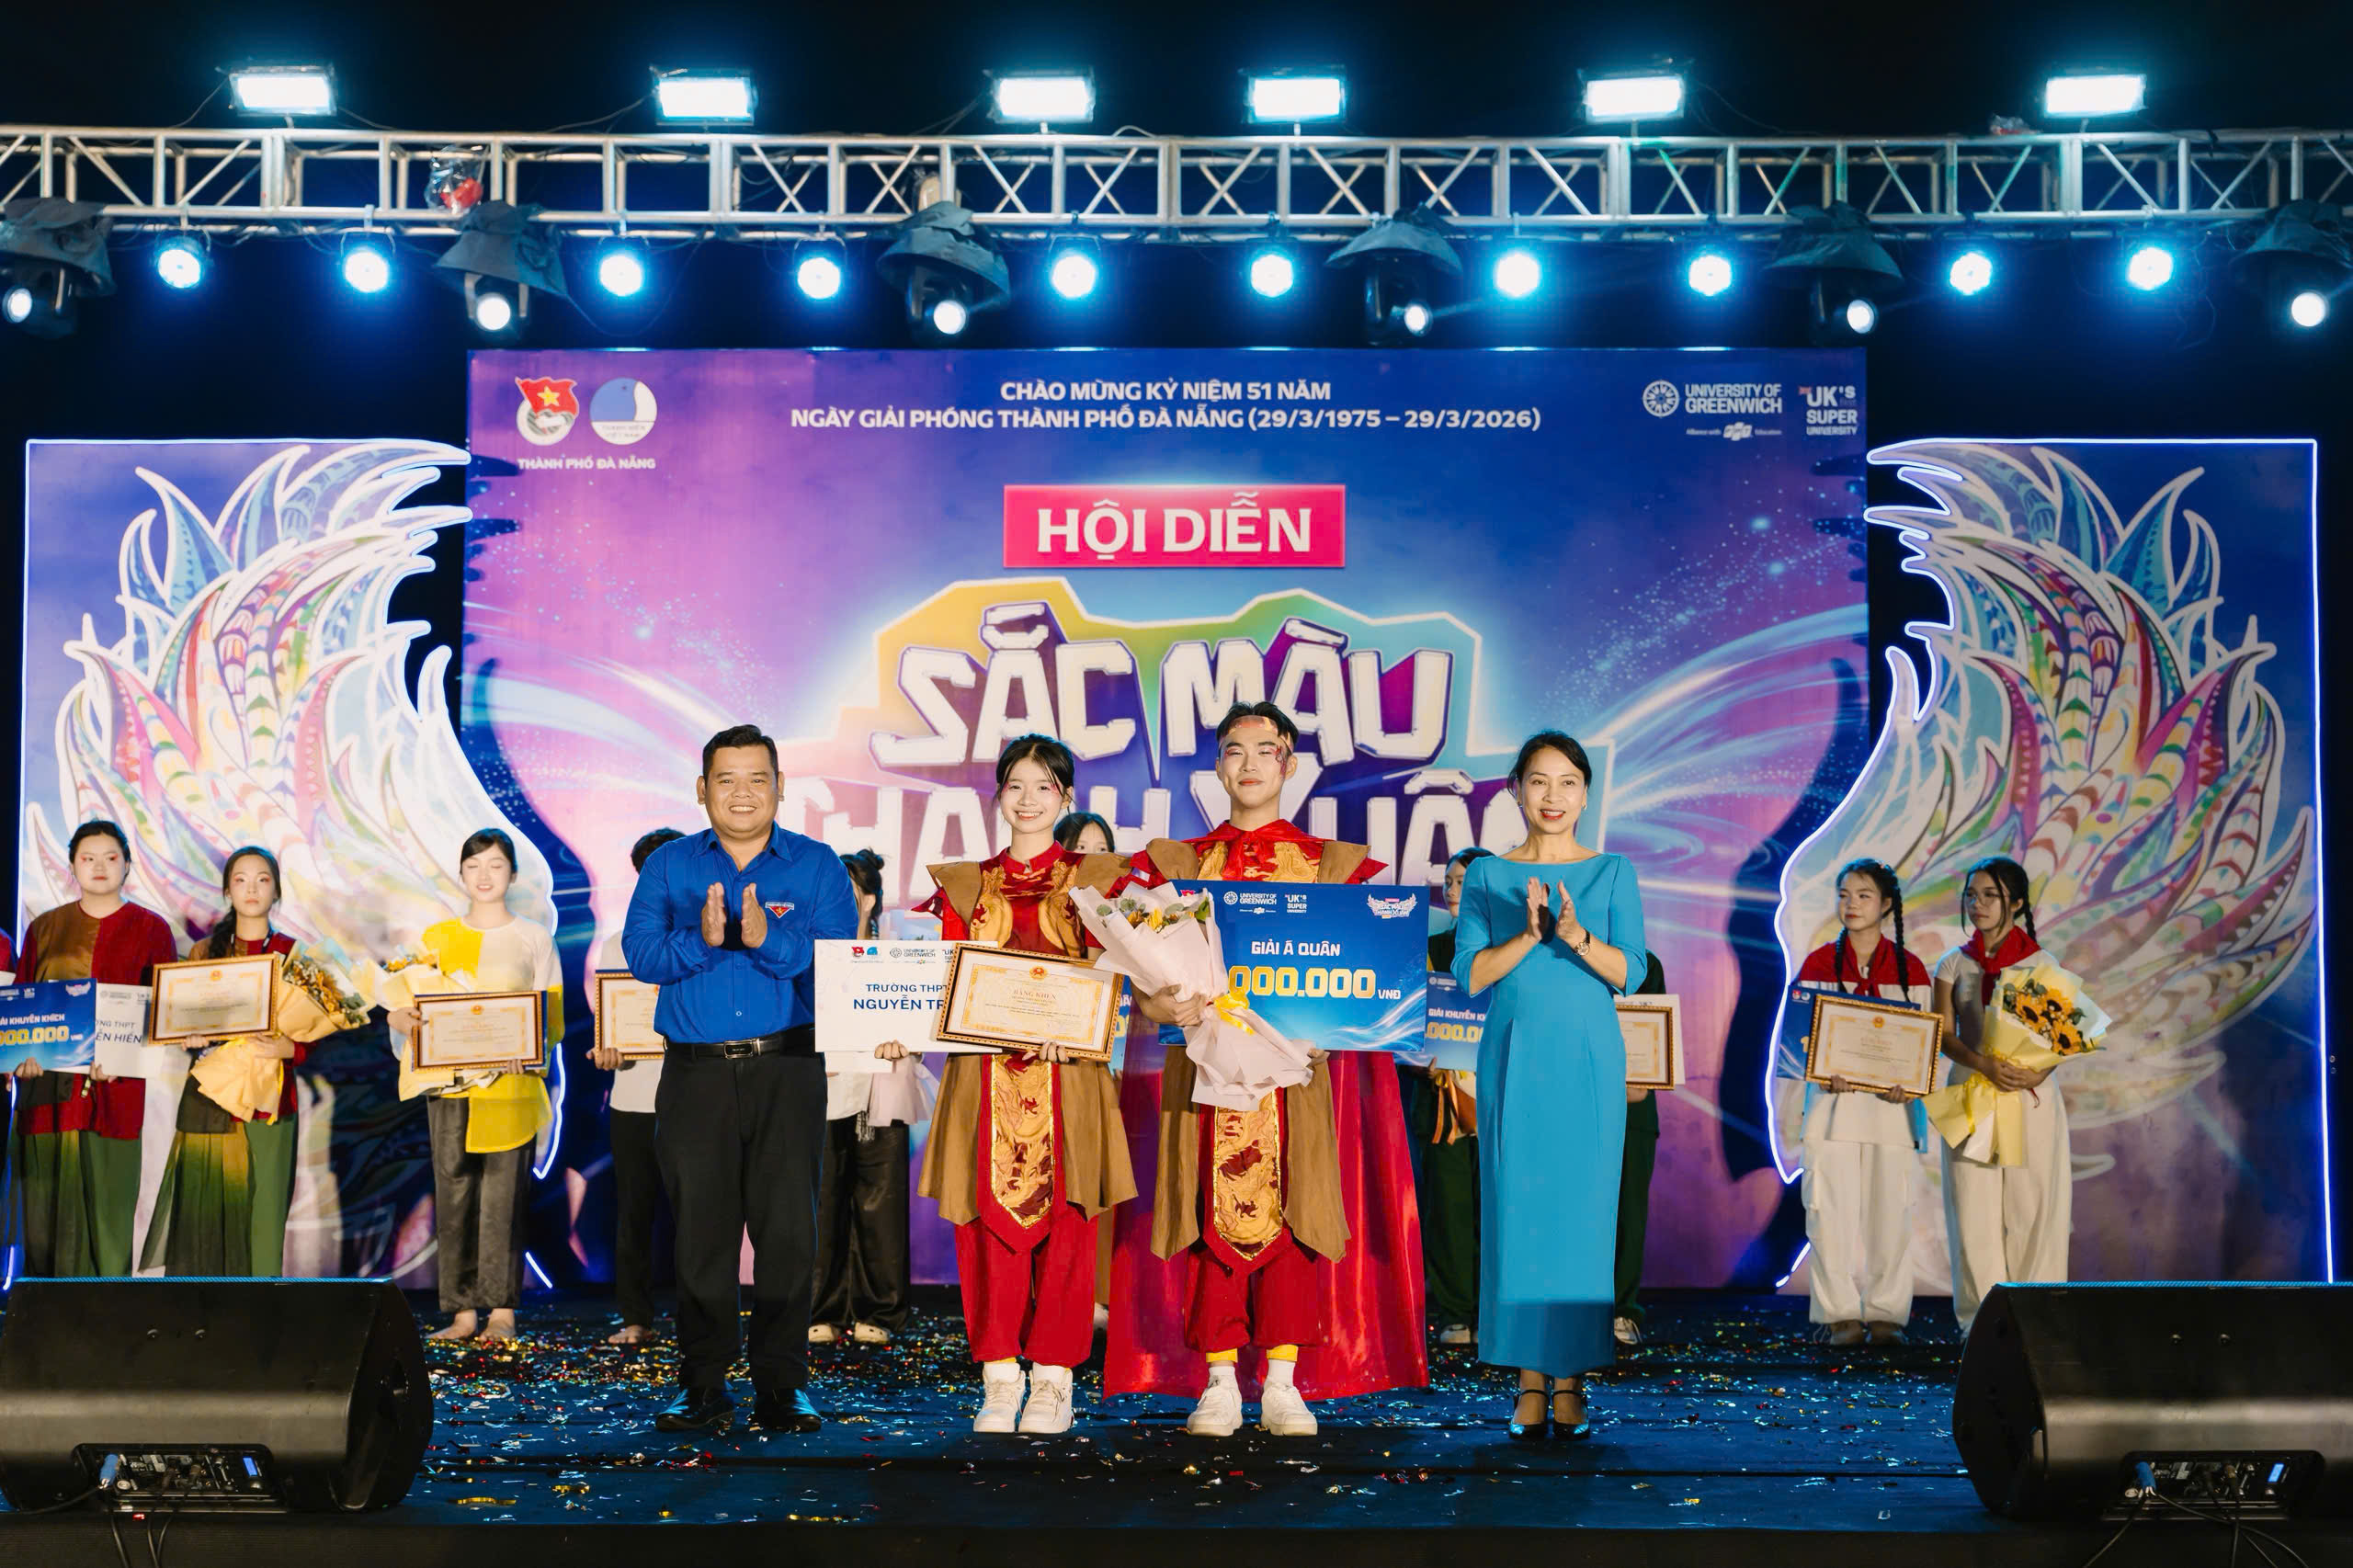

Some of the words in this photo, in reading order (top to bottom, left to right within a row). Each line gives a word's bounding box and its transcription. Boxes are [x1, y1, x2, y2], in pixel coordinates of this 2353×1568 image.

[1001, 379, 1065, 401] CHÀO
[1070, 379, 1142, 401] MỪNG
[1146, 378, 1178, 400] KỶ
[1183, 379, 1242, 403] NIỆM
[1246, 383, 1271, 400] 51
[1278, 379, 1330, 400] NĂM
[1685, 383, 1761, 397] UNIVERSITY
[1764, 383, 1781, 397] OF
[1806, 385, 1857, 407] UK'S
[1685, 398, 1782, 414] GREENWICH
[791, 405, 855, 428] NGÀY
[858, 404, 904, 428] GIẢI
[909, 406, 994, 428] PHÓNG
[997, 406, 1079, 427] THÀNH
[1085, 403, 1134, 428] PHỐ
[1138, 406, 1172, 427] ĐÀ
[1176, 403, 1243, 427] NẴNG
[1248, 407, 1381, 431] (29/3/1975
[1404, 407, 1541, 431] 29/3/2026)
[1806, 409, 1858, 424] SUPER
[1806, 426, 1858, 436] UNIVERSITY
[517, 456, 563, 470] THÀNH
[565, 455, 593, 470] PHỐ
[597, 456, 616, 470] ĐÀ
[1038, 499, 1147, 560] HỘI
[1163, 492, 1312, 553] DIỄN
[870, 602, 1136, 766] SẮC
[1162, 618, 1452, 767] MÀU
[1251, 938, 1279, 955] GIẢI
[1283, 939, 1294, 955] Á
[1298, 940, 1341, 957] QUÂN
[866, 982, 917, 992] TRƯỜNG
[1228, 965, 1376, 999] 000.000
[1378, 989, 1402, 1000] VNĐ
[853, 994, 922, 1010] NGUYỄN
